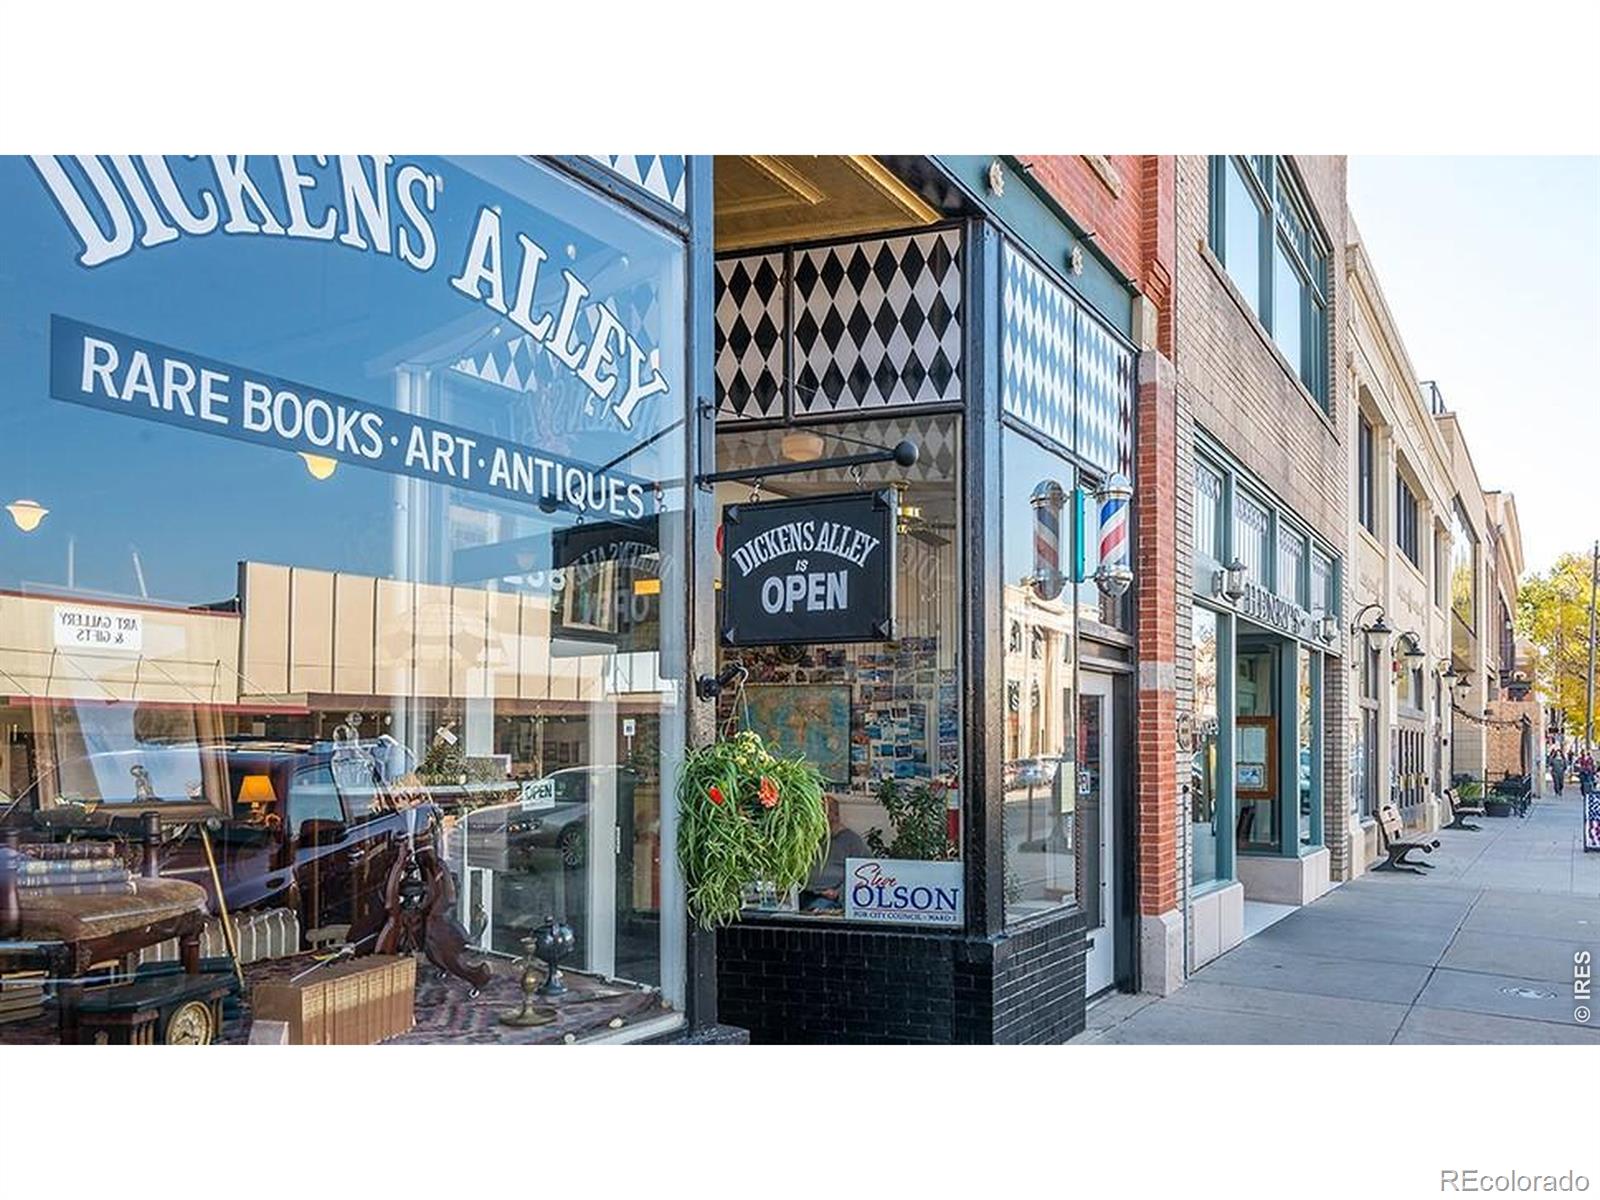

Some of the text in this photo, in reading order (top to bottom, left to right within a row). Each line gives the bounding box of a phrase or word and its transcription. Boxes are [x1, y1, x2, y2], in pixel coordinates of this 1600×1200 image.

[451, 207, 669, 430] ALLEY
[81, 337, 645, 520] RARE BOOKS ART ANTIQUES
[731, 520, 881, 577] DICKENS ALLEY
[794, 558, 809, 573] IS
[761, 570, 848, 614] OPEN
[852, 886, 959, 911] OLSON
